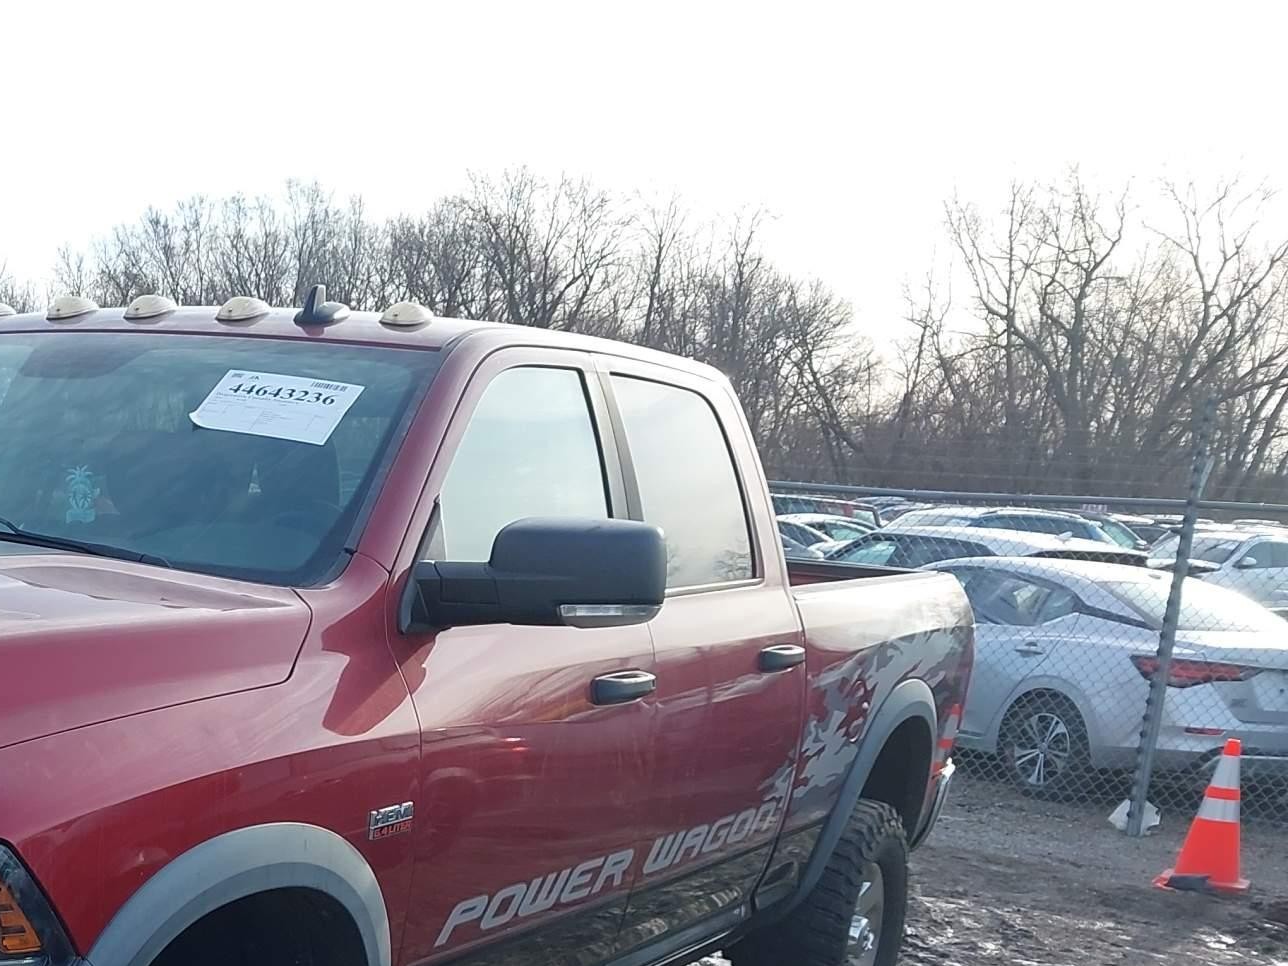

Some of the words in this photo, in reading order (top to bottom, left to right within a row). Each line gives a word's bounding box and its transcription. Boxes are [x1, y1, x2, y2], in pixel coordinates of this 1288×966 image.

[229, 383, 336, 406] 44643236
[370, 801, 413, 829] HEMI
[434, 849, 634, 947] POWER
[642, 800, 780, 874] WAGON
